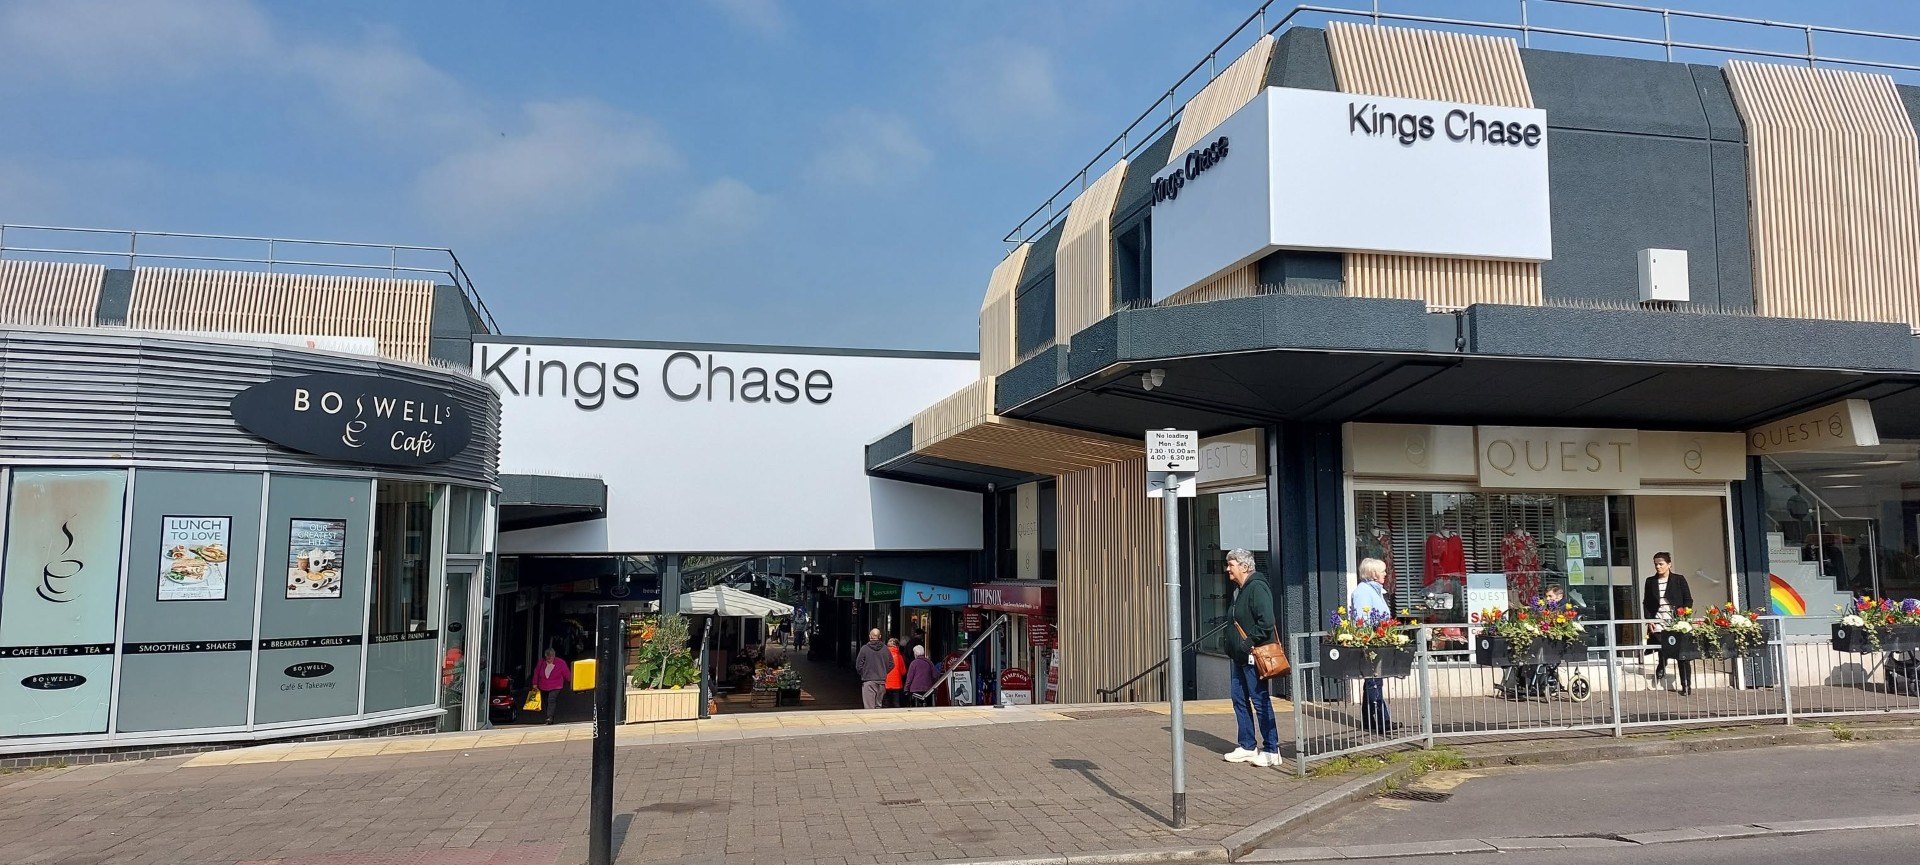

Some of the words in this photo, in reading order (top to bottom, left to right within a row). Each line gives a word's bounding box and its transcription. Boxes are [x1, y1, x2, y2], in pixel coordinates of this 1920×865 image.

[1348, 102, 1436, 146] Kings
[1444, 108, 1542, 148] Chase
[1151, 168, 1185, 206] Kings
[1185, 136, 1230, 180] Chase
[481, 345, 640, 411] Kings
[662, 351, 834, 404] Chase
[1751, 419, 1824, 450] QUEST
[390, 430, 436, 457] Café
[1487, 439, 1631, 477] QUEST
[171, 519, 222, 530] LUNCH
[309, 523, 328, 532] OUR
[171, 531, 188, 540] TO
[192, 531, 221, 540] LOVE
[298, 531, 337, 540] GREATEST
[308, 538, 327, 546] HITS
[937, 593, 951, 601] TUI
[973, 588, 1002, 606] TIMPSON
[375, 634, 399, 642] TOASTIES
[408, 632, 425, 640] PANINI
[138, 643, 191, 652] SMOOTHIES
[205, 642, 237, 650] SHAKES
[270, 639, 309, 648] BREAKFAST
[320, 637, 343, 646] GRILLS
[12, 646, 39, 656] CAFFÉ
[42, 647, 68, 655] LATTE
[84, 646, 100, 654] TEA
[1002, 672, 1028, 682] TIMPSON
[280, 683, 296, 691] Café
[305, 681, 336, 690] Takeaway
